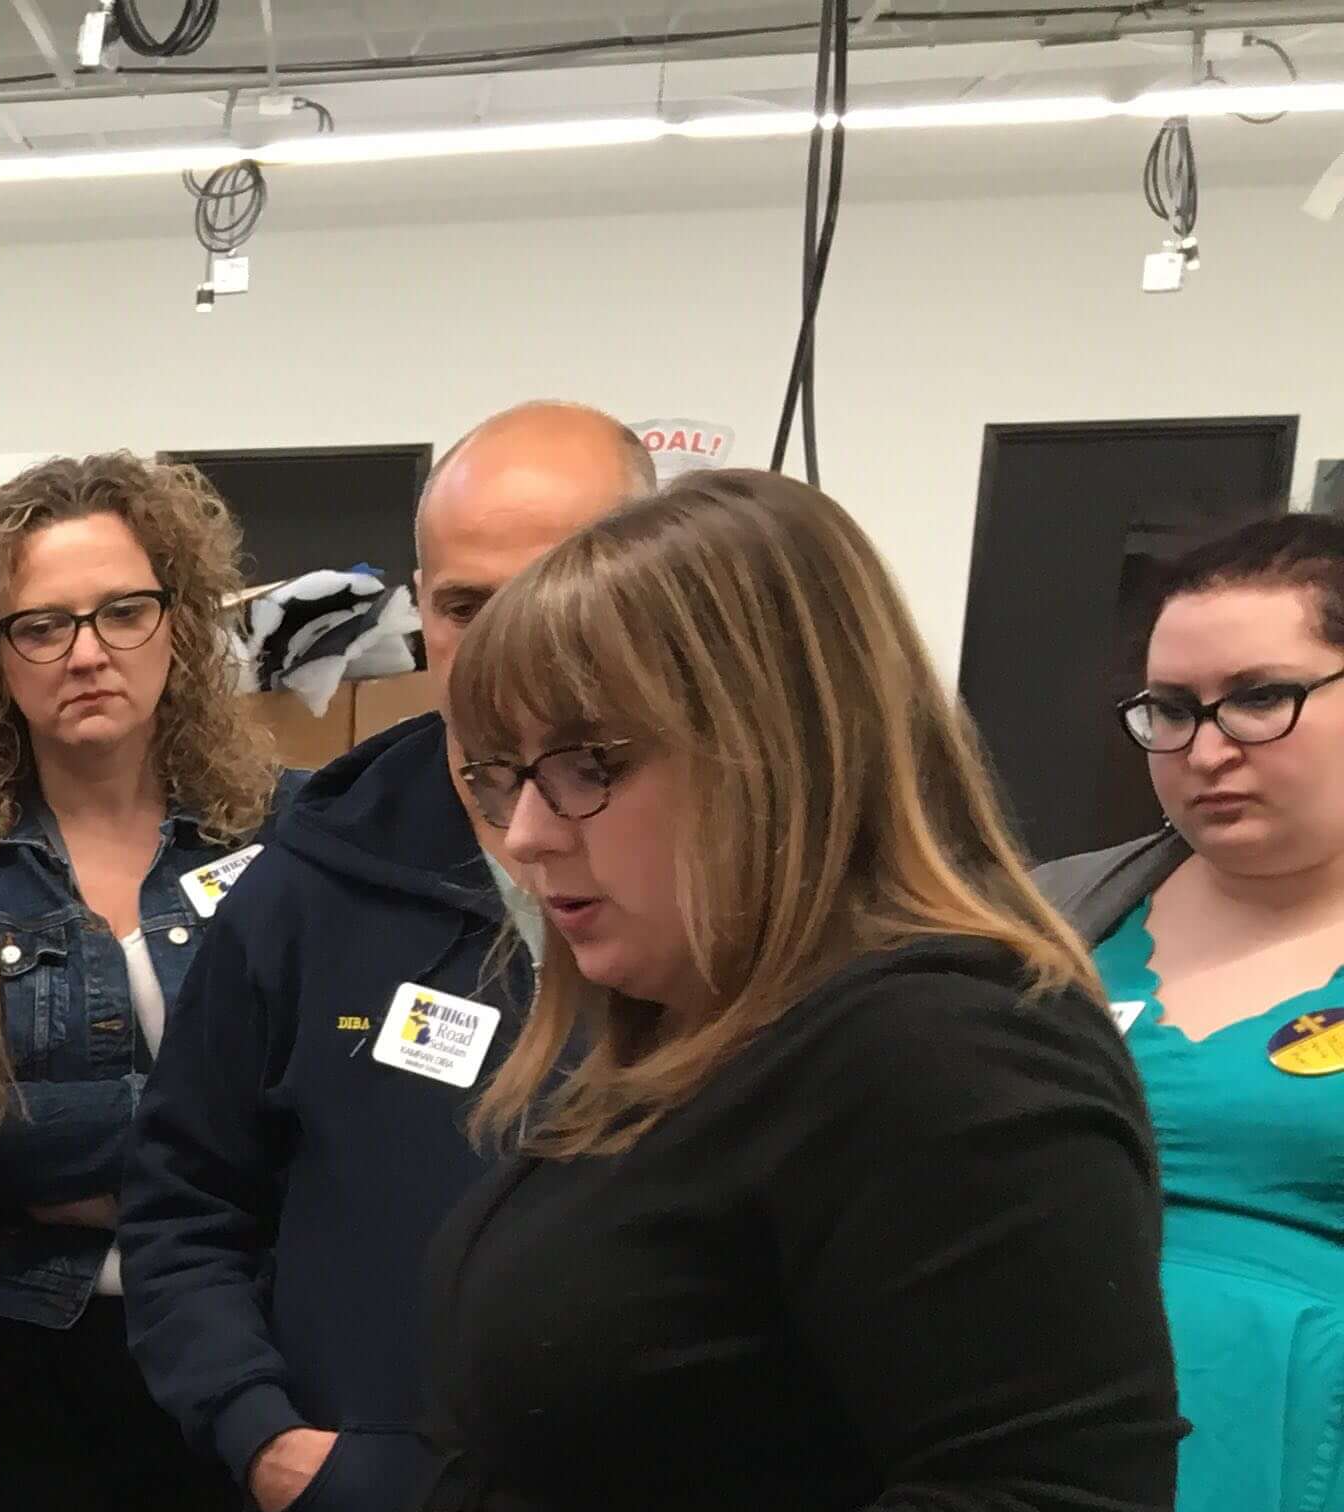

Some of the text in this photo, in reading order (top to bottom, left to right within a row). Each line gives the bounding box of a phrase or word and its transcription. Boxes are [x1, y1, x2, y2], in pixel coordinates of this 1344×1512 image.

[638, 431, 722, 456] OAL!
[337, 1017, 370, 1030] DIBA
[412, 998, 479, 1029] MICHIGAN
[436, 1022, 475, 1047] Road
